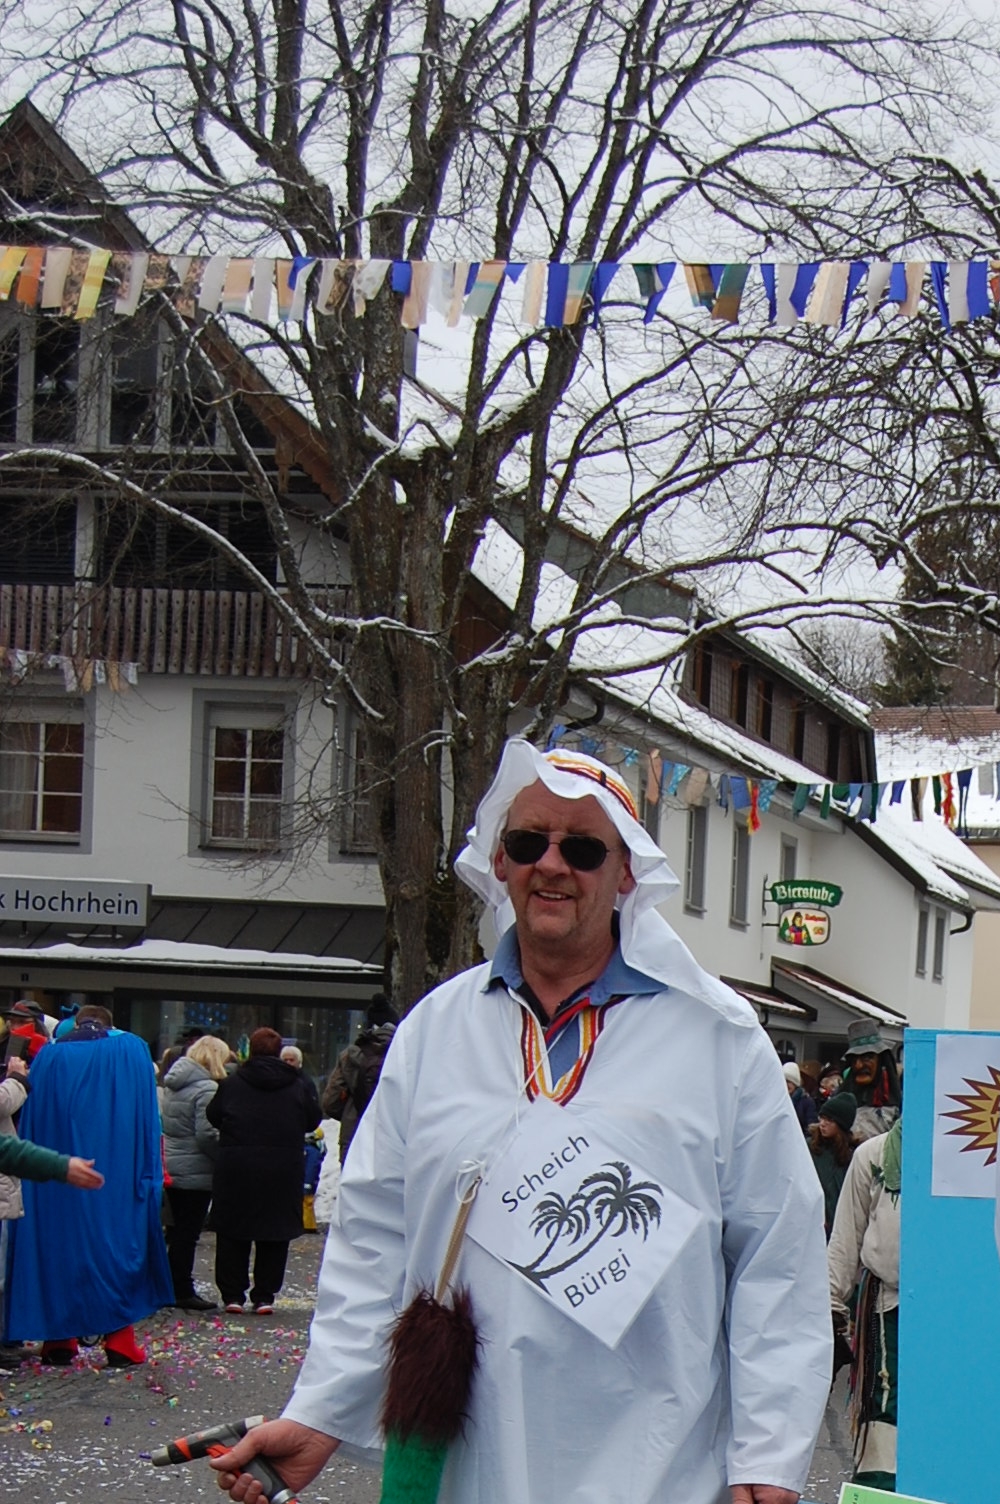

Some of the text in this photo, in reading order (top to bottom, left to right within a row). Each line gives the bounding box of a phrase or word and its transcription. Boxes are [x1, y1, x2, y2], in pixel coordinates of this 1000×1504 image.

[14, 889, 138, 915] Hochrhein
[775, 885, 835, 903] Bierstube
[501, 1136, 590, 1213] Scheich
[563, 1248, 631, 1308] Bürgi
